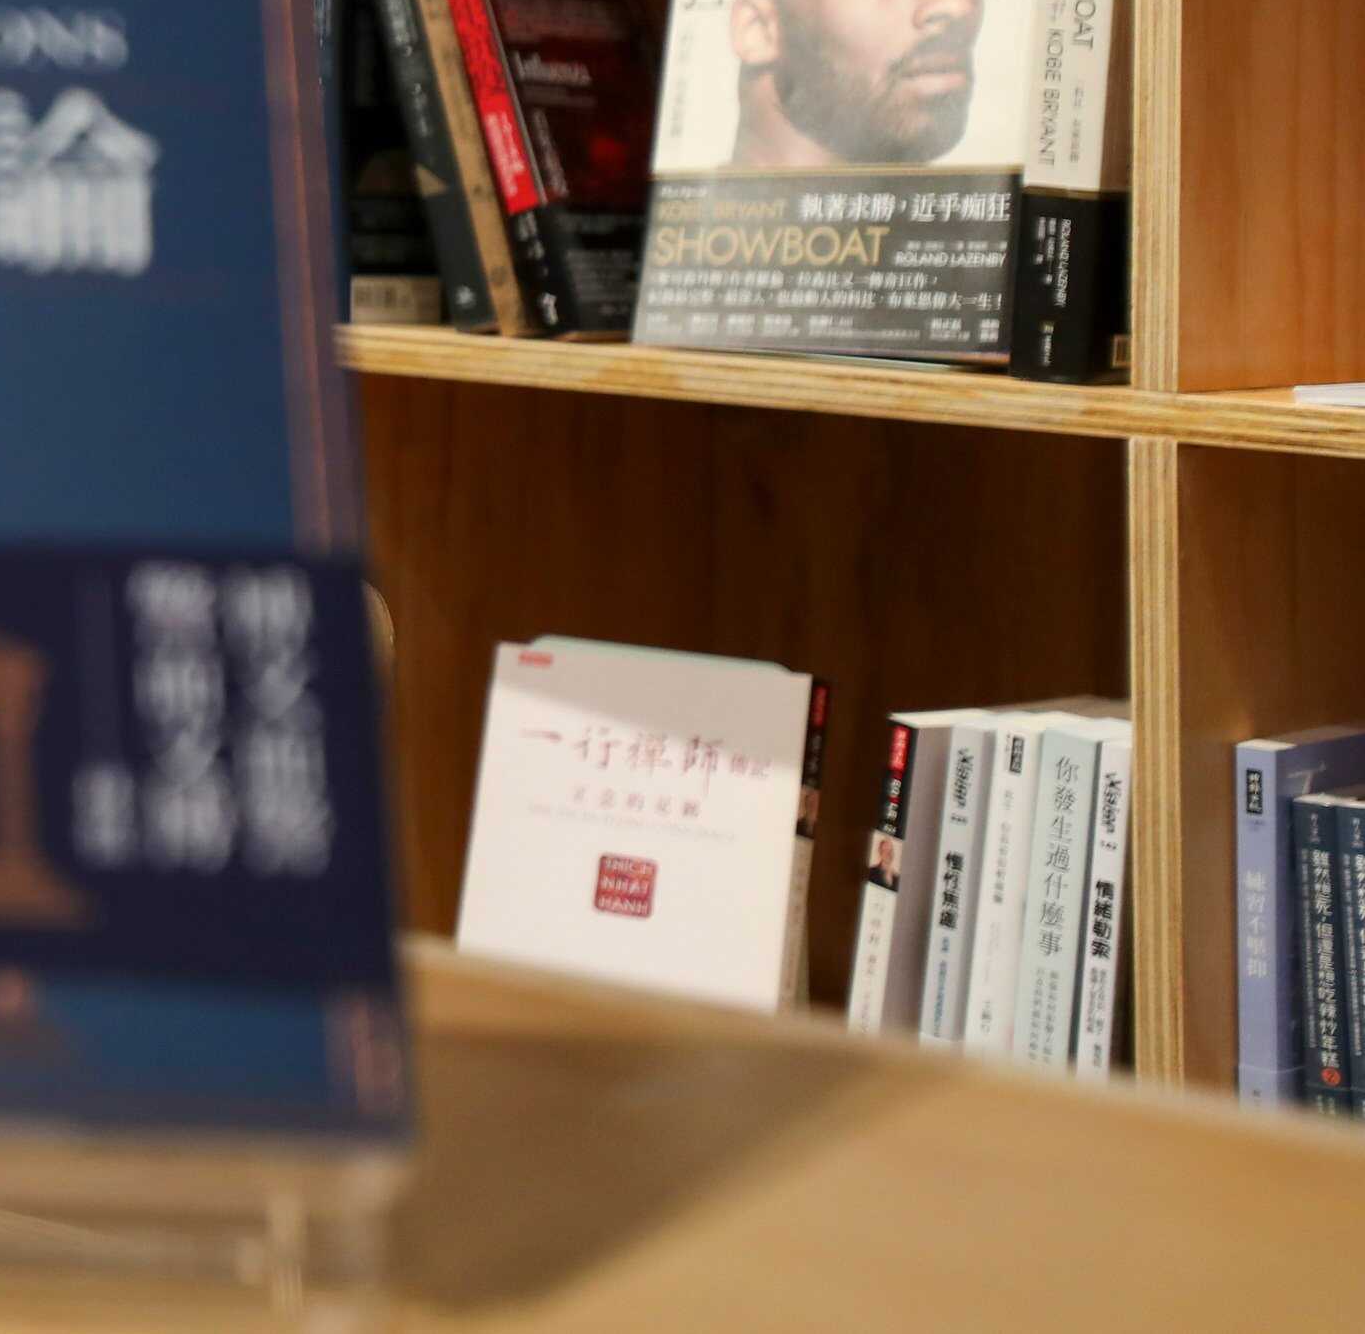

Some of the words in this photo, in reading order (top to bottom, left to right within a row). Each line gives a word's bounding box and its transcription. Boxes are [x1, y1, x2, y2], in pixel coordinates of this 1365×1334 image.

[1045, 28, 1064, 82] KOBE
[1038, 88, 1061, 166] BRYANT
[654, 225, 890, 266] SHOWBOAT
[895, 252, 947, 266] ROLAND
[951, 252, 1007, 267] LAZENBY
[1038, 755, 1080, 959] 你發生過什麼事
[598, 895, 649, 916] HANH
[601, 875, 648, 894] NHAT
[1091, 878, 1116, 960] 情緒勒索
